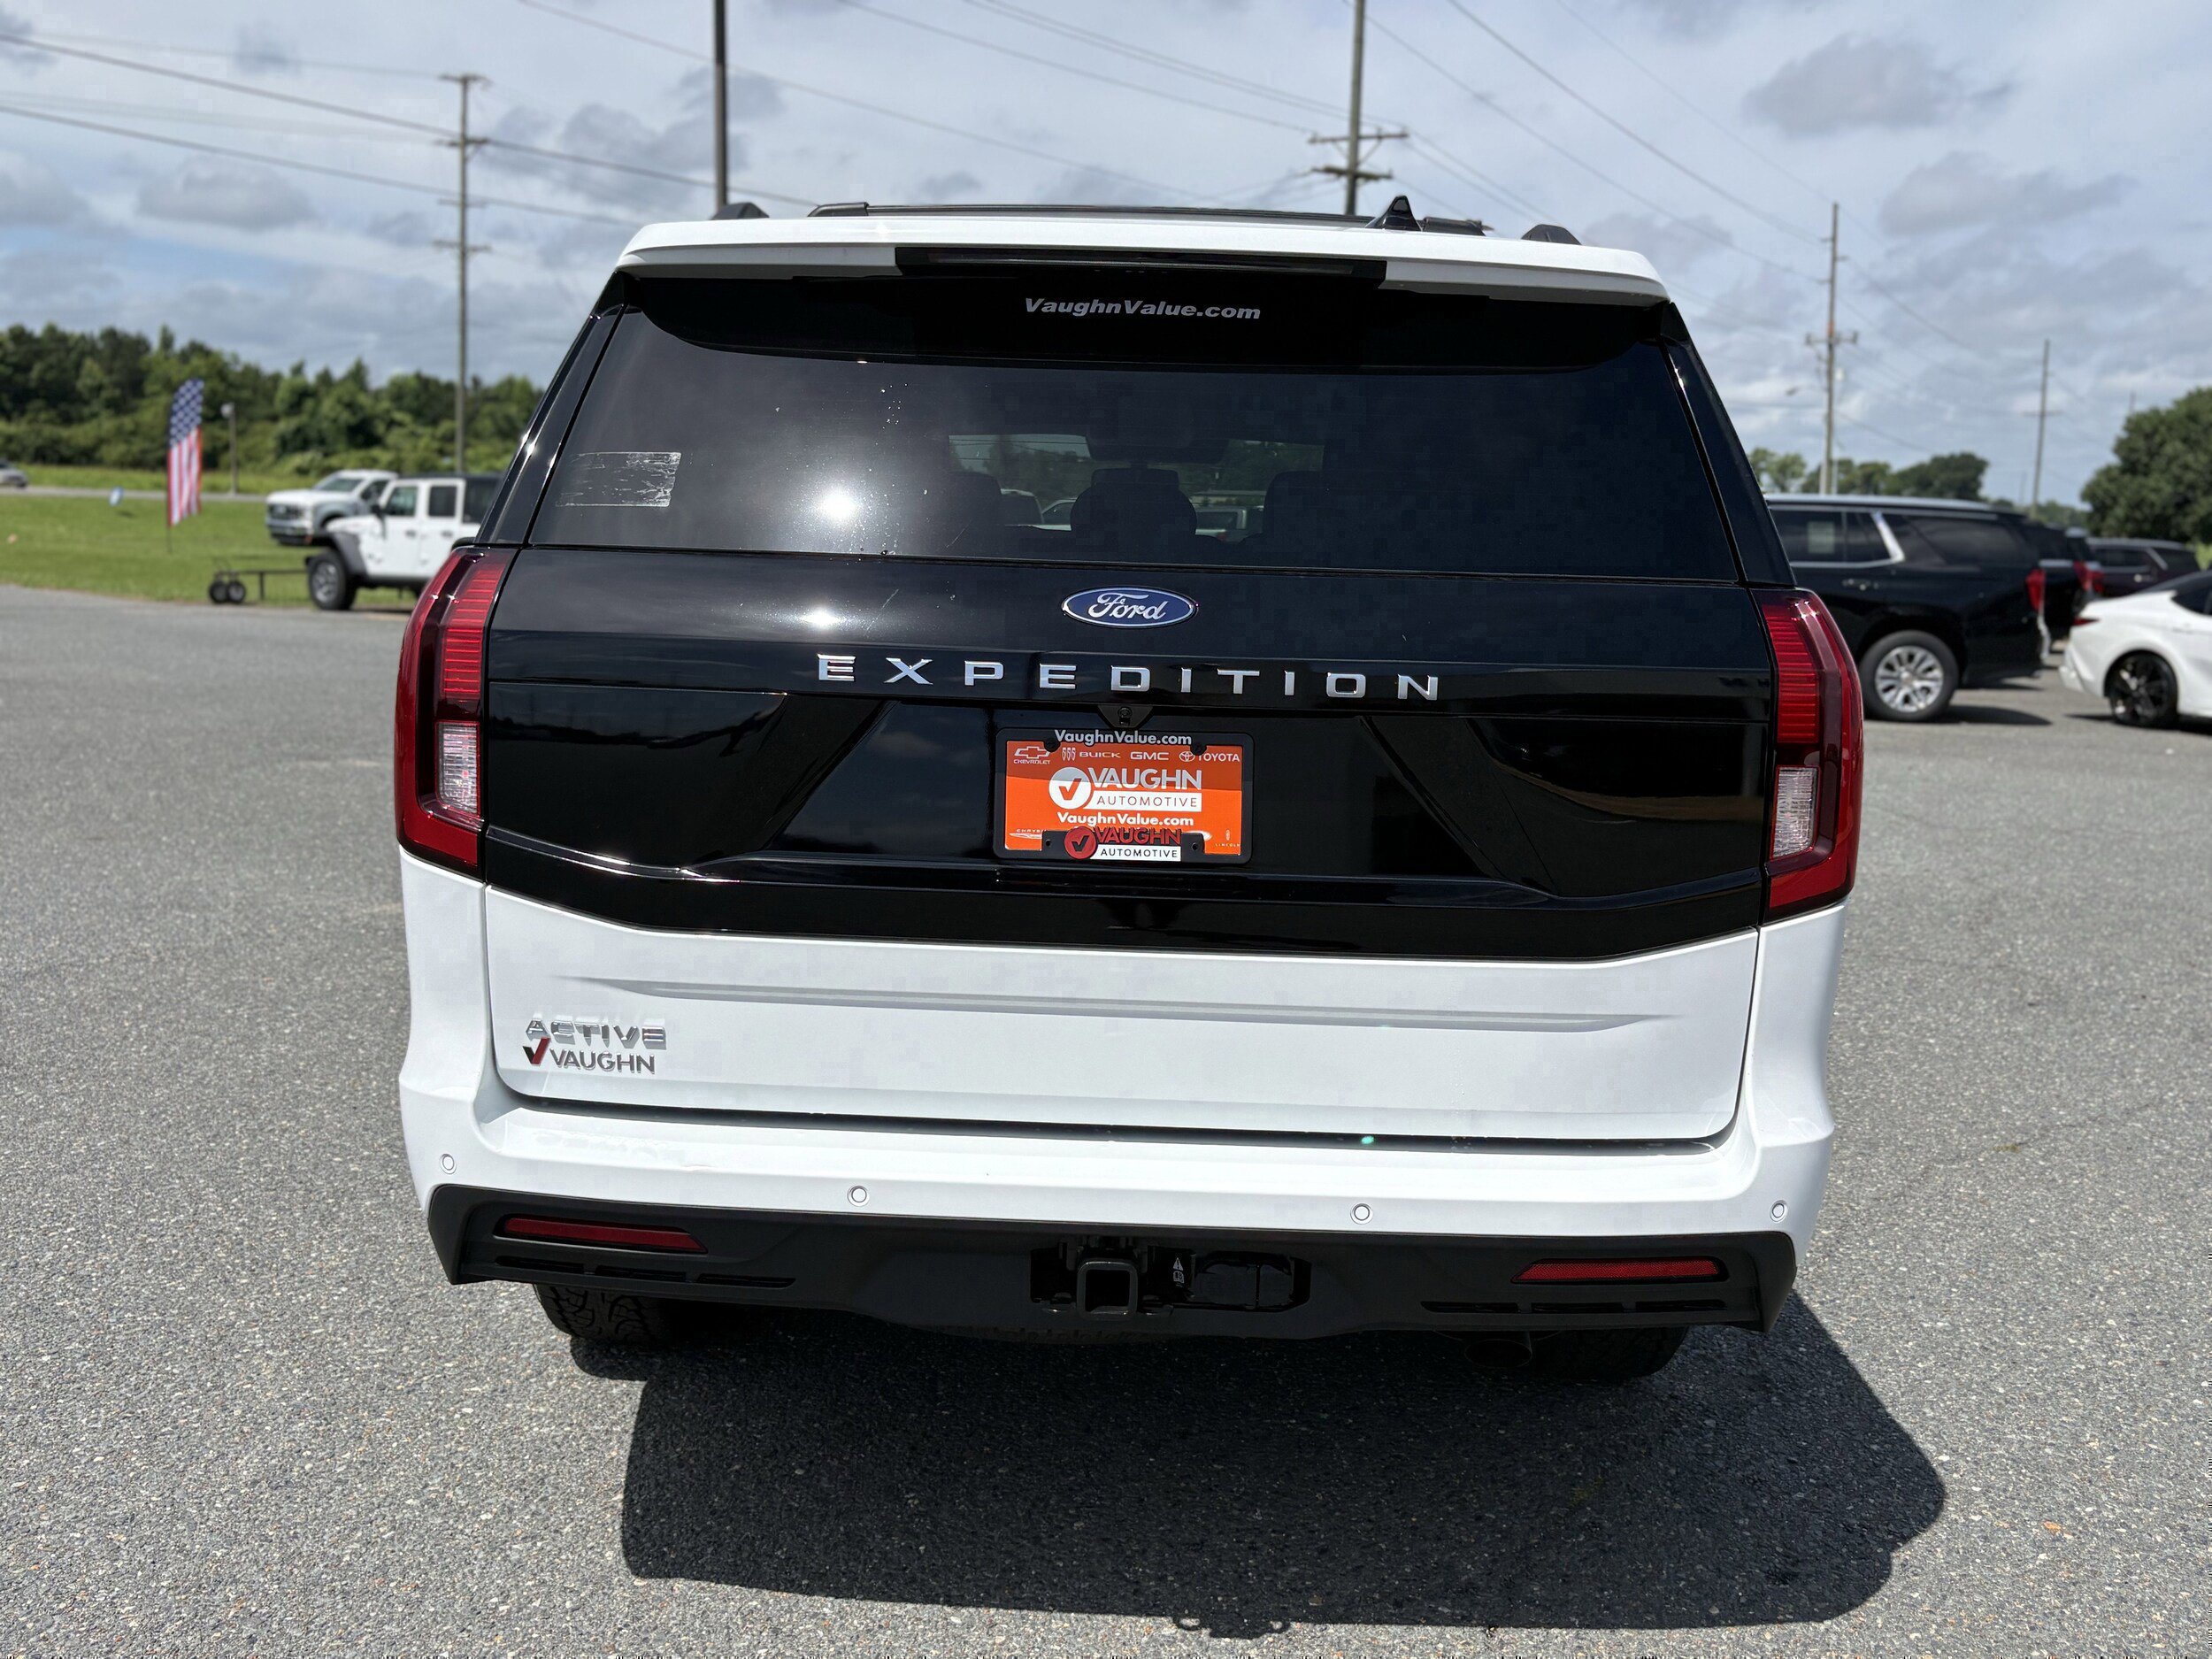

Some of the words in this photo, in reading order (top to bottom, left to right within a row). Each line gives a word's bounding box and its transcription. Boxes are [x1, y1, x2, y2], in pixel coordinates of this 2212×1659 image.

[1025, 297, 1261, 319] VaughnValue.com
[1088, 592, 1168, 620] Ford
[818, 653, 1439, 702] EXPEDITION
[1054, 729, 1192, 746] VaughnValue.com
[1130, 751, 1169, 760] GMC
[1087, 767, 1202, 790] VAUGHN
[1097, 795, 1197, 808] AUTOMOTIVE
[1057, 811, 1194, 826] VaughnValue.com
[1094, 826, 1182, 845] VAUGHN
[1101, 848, 1179, 858] AUTOMOTIVE
[526, 1017, 667, 1050] ACTIVE
[549, 1048, 656, 1074] VAUGHN
